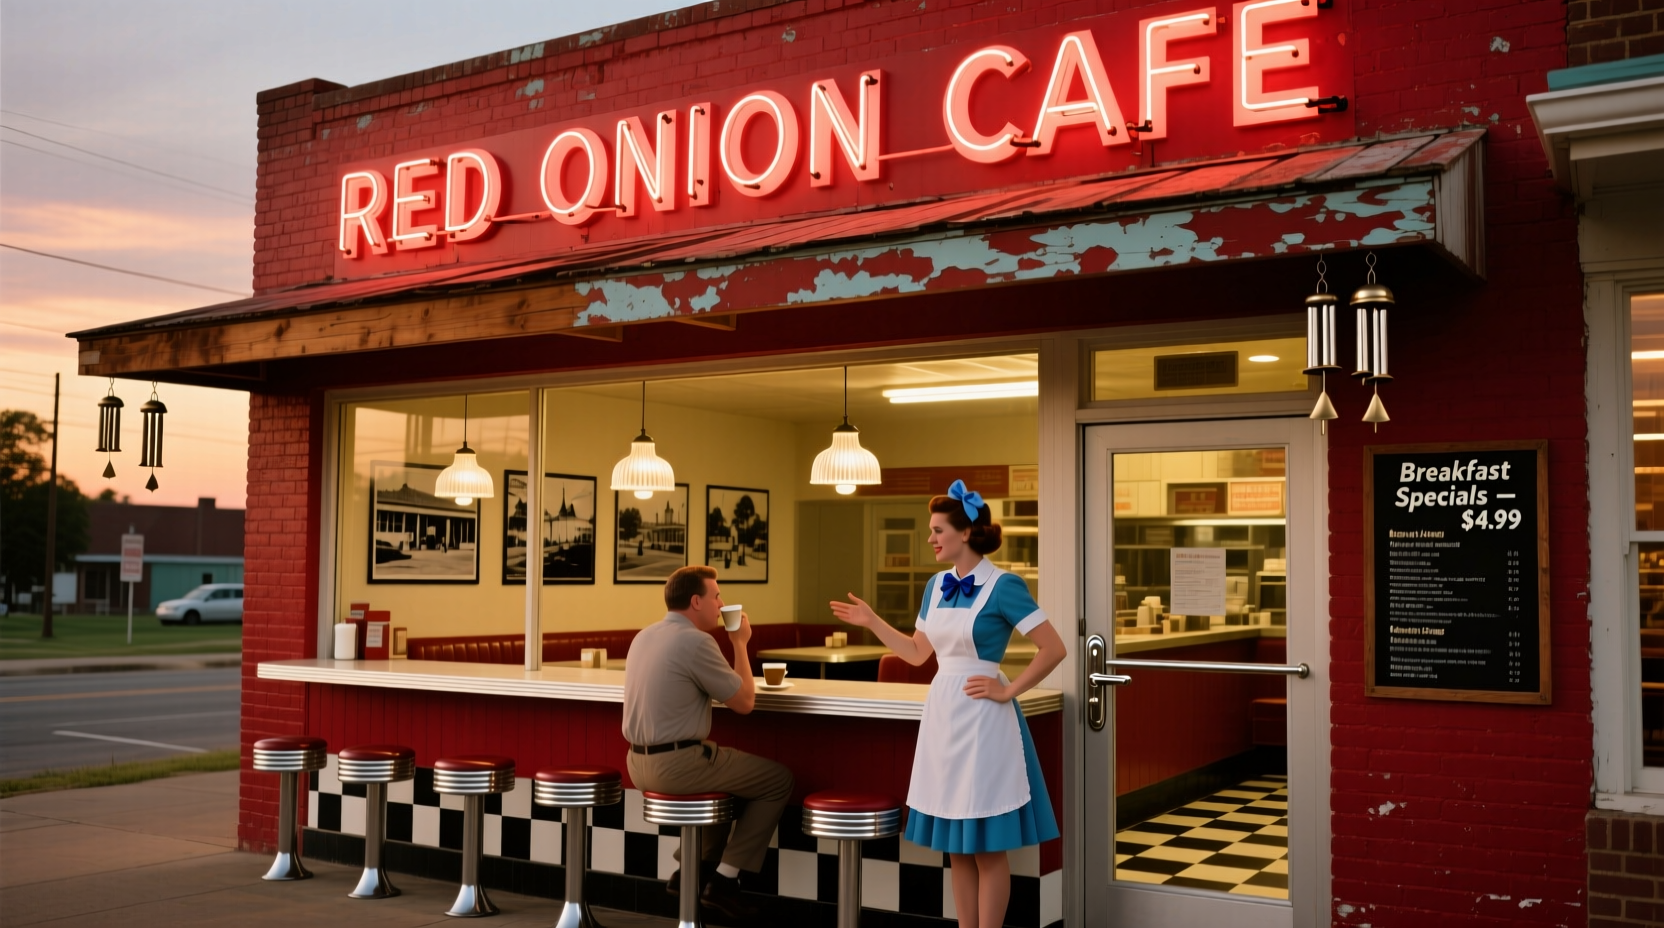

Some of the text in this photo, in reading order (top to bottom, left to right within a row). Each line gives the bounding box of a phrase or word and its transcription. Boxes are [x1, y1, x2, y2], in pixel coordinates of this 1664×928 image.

[339, 0, 1319, 259] RED ONION CAFE
[1400, 459, 1511, 483] Breakfast
[1394, 485, 1488, 513] Specials
[1461, 508, 1522, 531] $4.99
